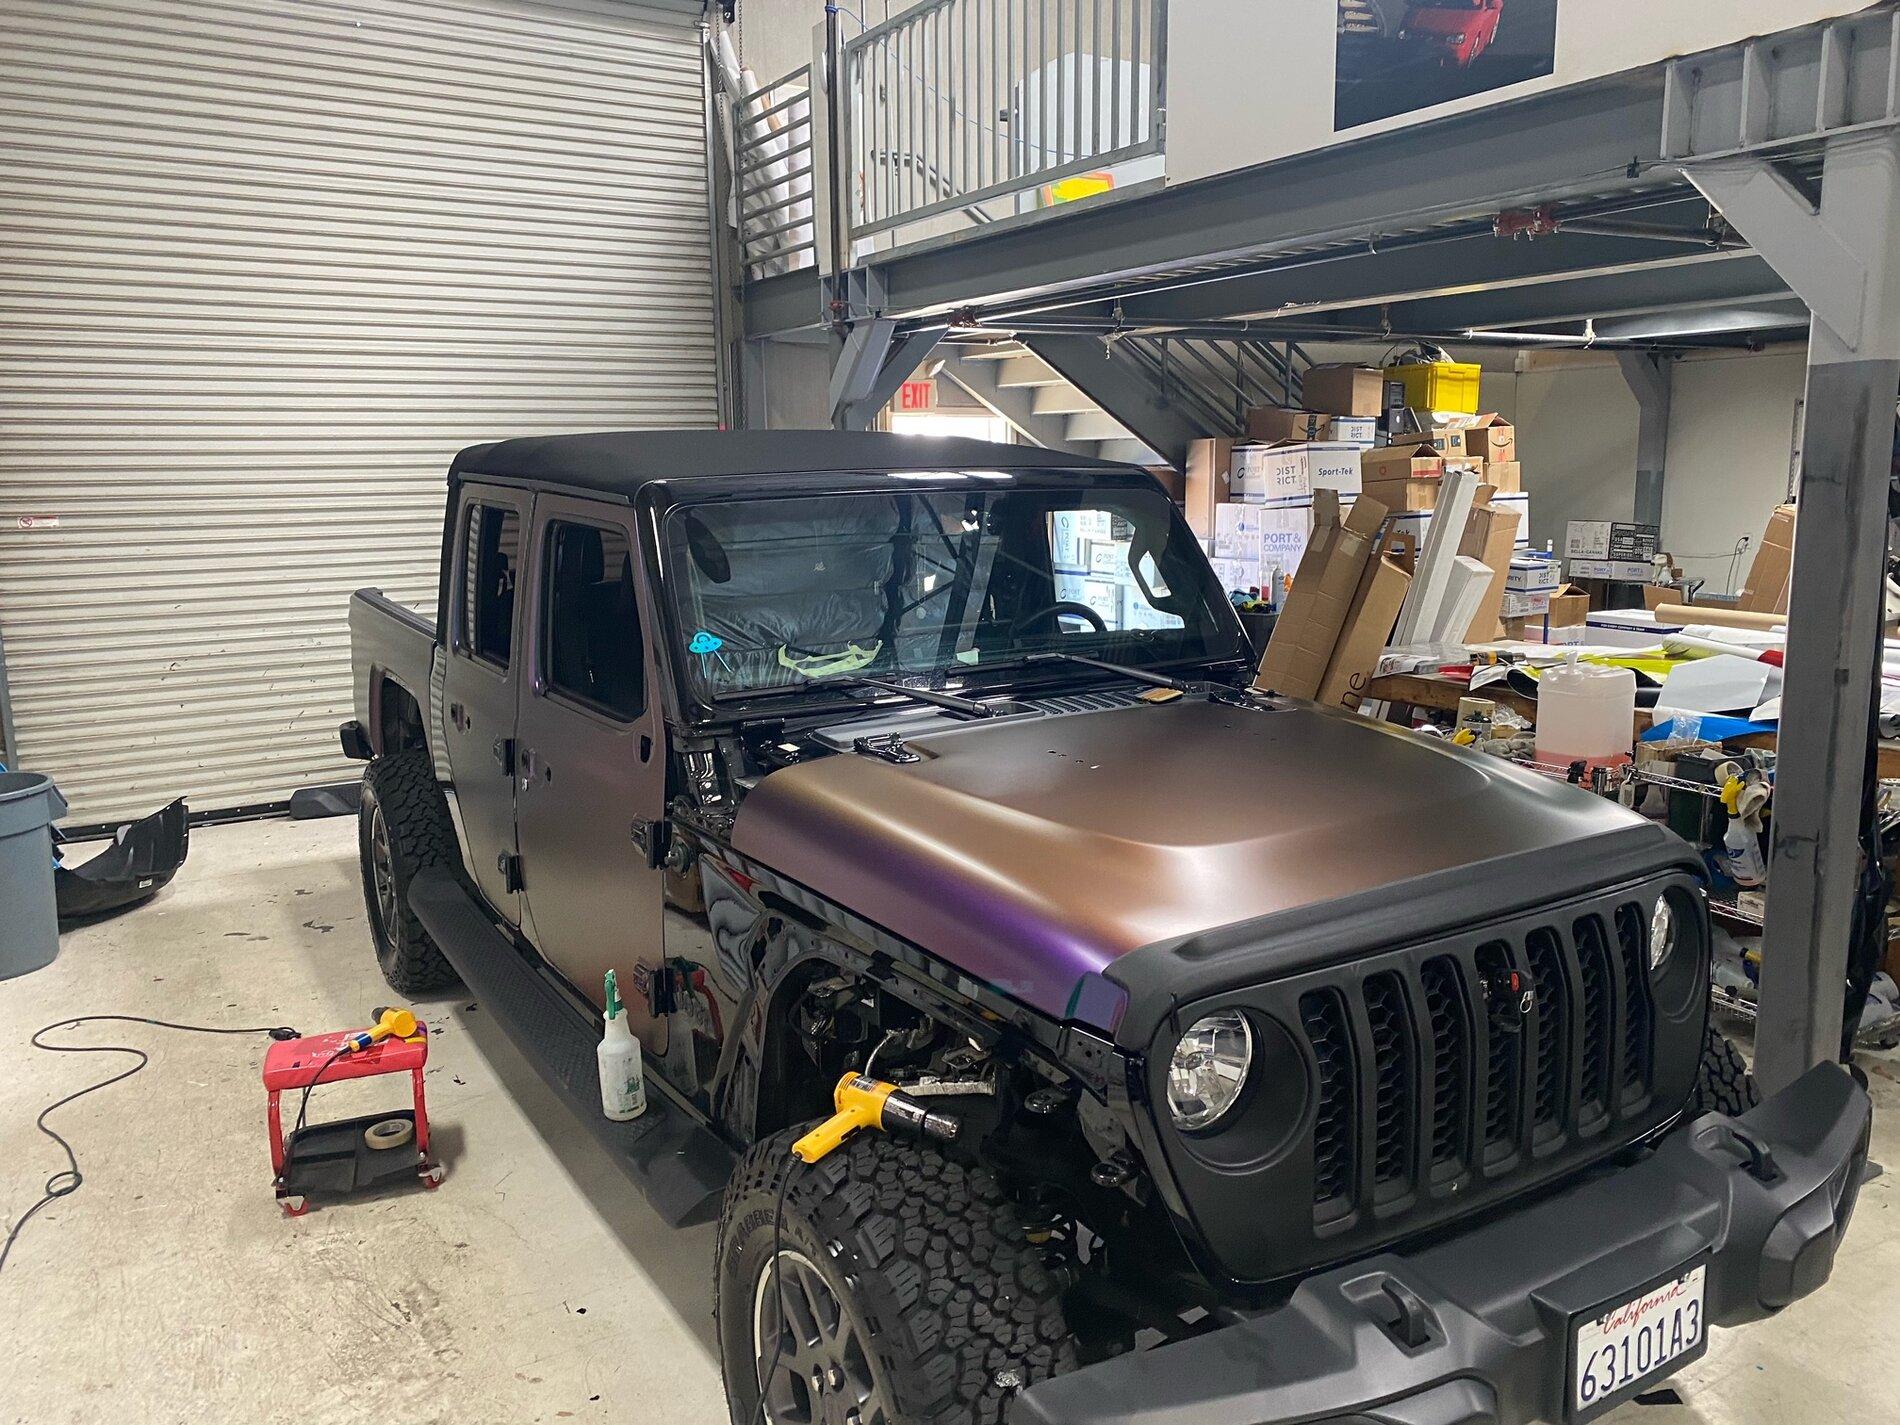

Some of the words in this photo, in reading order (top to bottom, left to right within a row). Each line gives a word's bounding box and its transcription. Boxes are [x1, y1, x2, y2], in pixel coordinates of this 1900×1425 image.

[901, 382, 931, 409] EXIT
[1318, 467, 1354, 478] Sport-Tek
[1263, 533, 1292, 543] PORT
[1293, 533, 1302, 543] &
[1263, 543, 1302, 552] COMPANY
[1603, 1283, 1686, 1335] California
[1580, 1298, 1700, 1402] 63101A3
